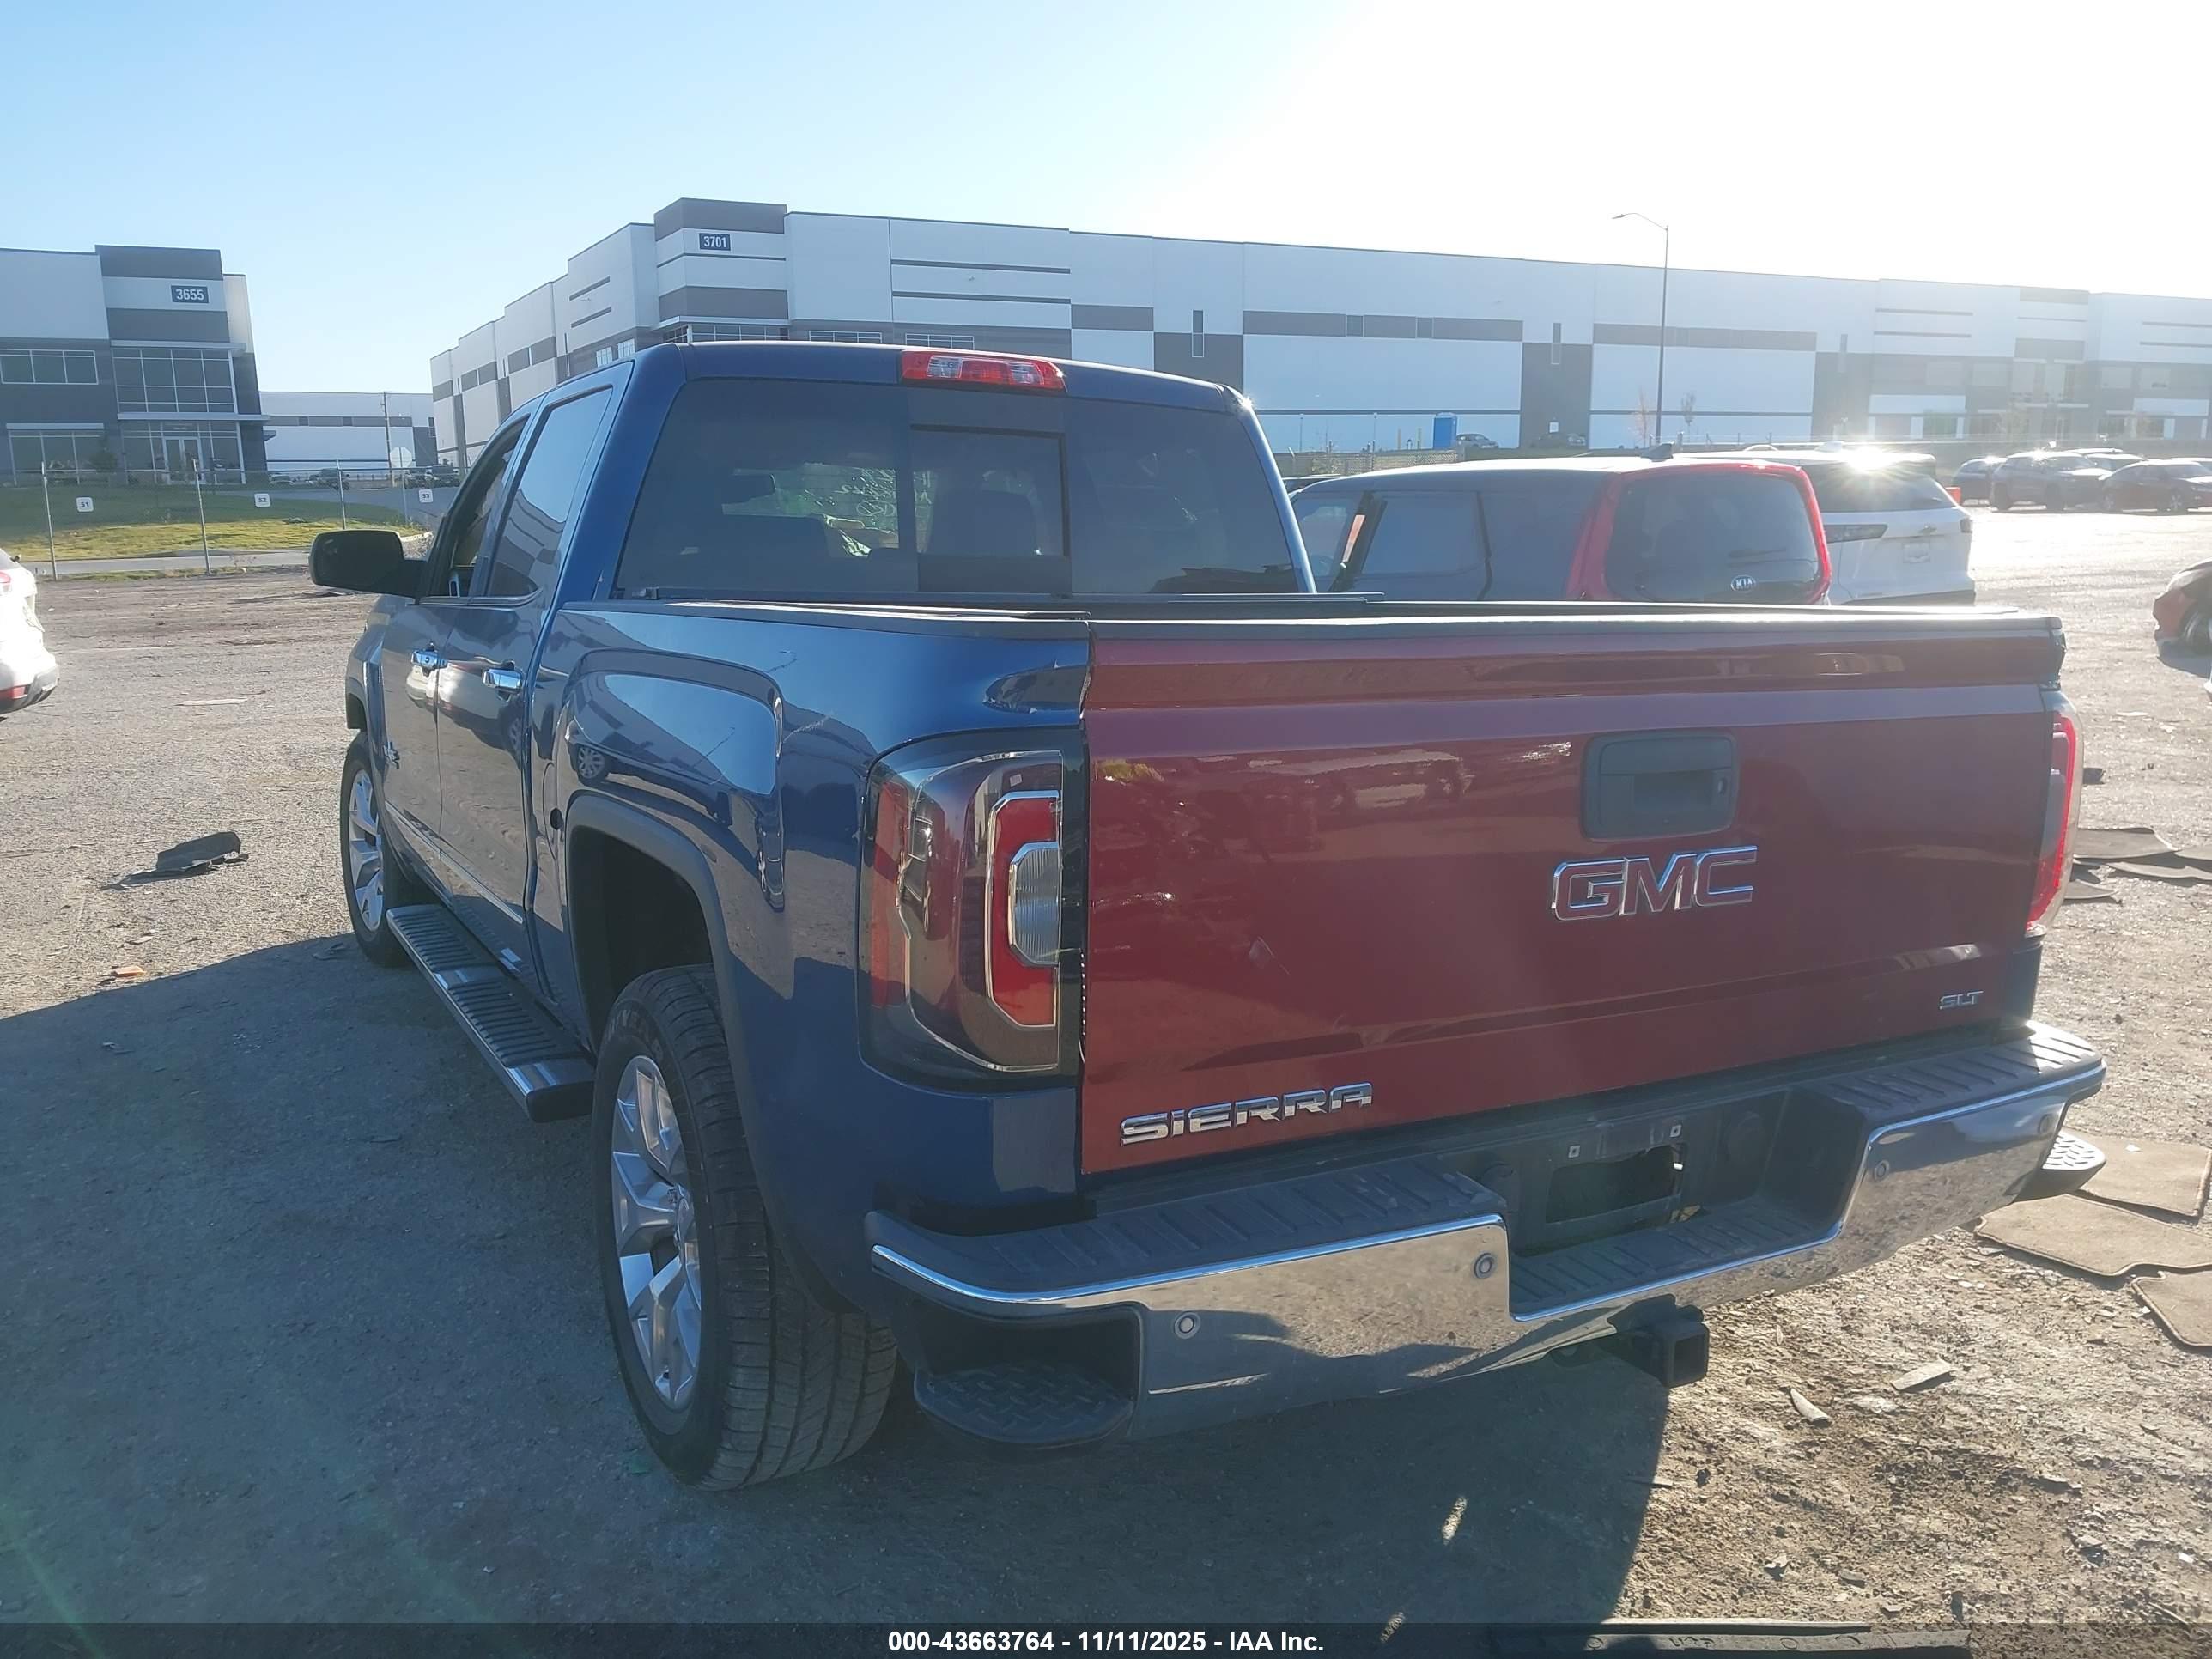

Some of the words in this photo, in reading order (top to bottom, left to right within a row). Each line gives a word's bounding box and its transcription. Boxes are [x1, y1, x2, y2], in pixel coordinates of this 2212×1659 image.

[703, 236, 726, 248] 3701
[175, 289, 204, 301] 3655
[1552, 846, 1758, 921] GMC
[1939, 990, 1984, 1010] SLT
[1120, 1081, 1373, 1147] SIERRA
